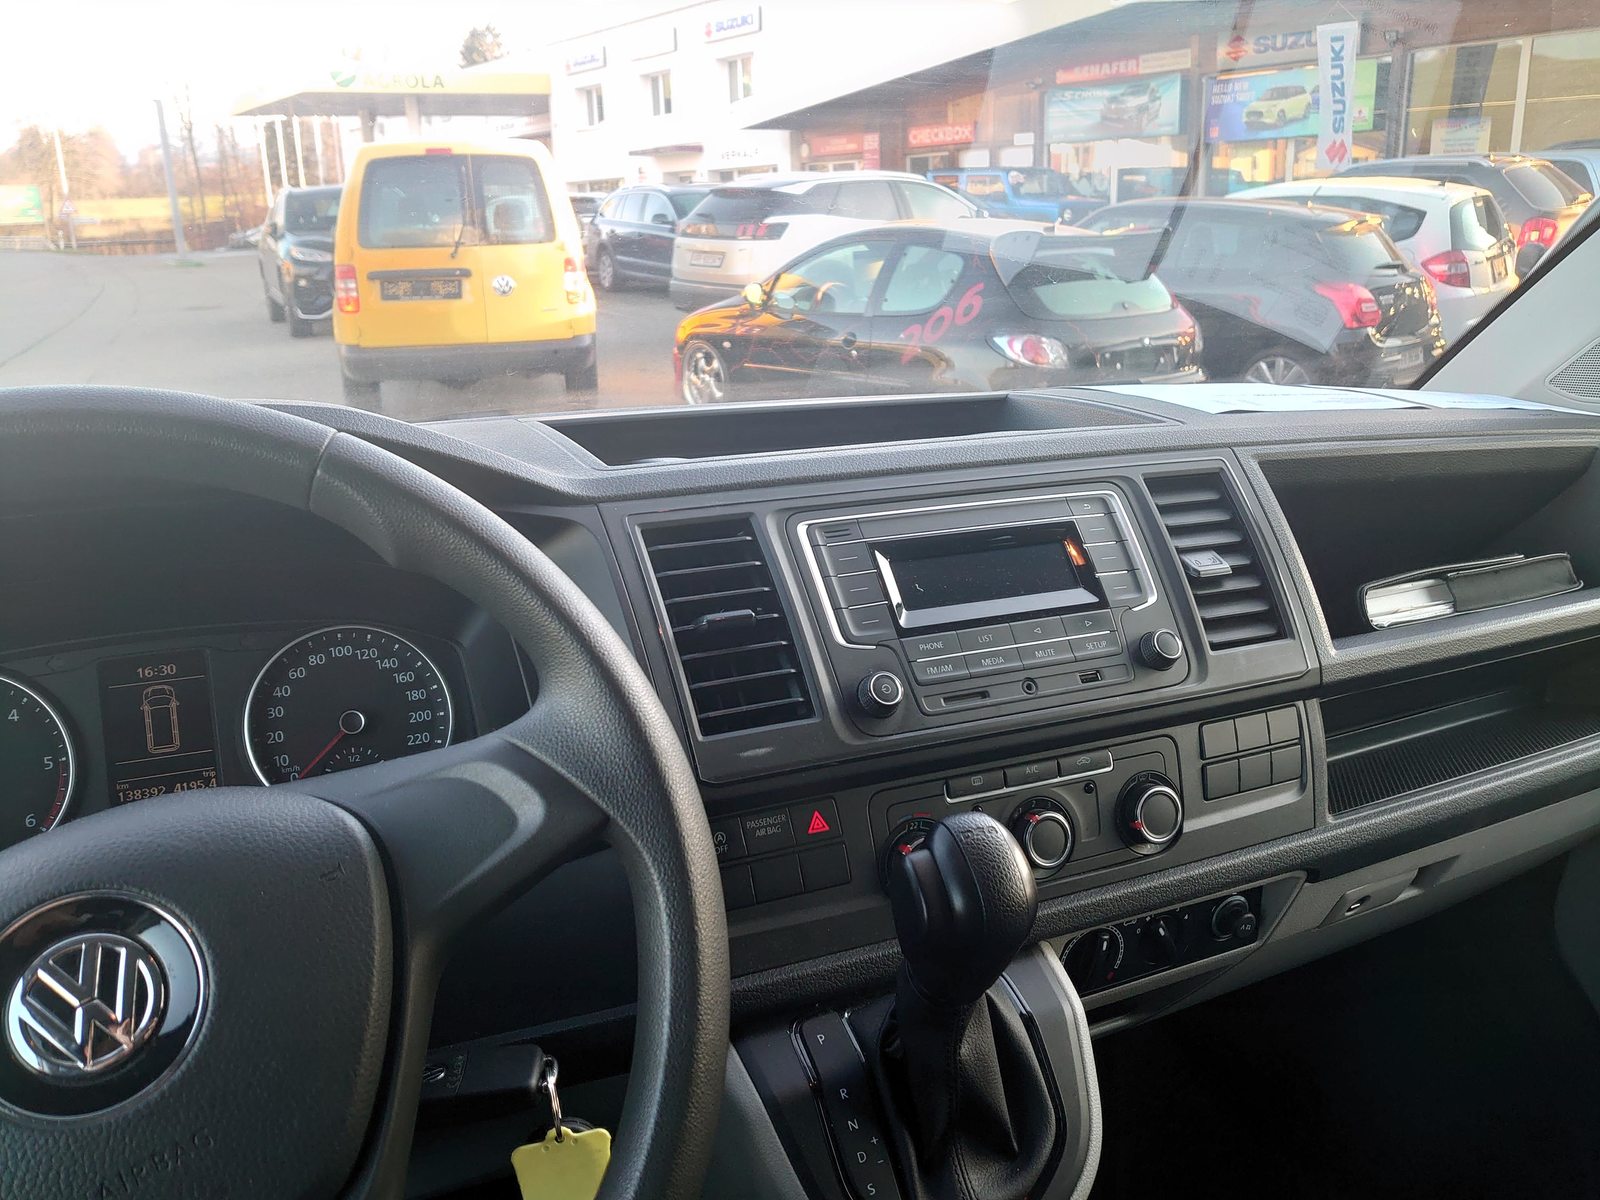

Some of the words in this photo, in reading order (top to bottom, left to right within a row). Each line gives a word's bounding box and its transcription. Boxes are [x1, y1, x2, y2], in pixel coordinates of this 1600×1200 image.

[716, 14, 753, 32] SUZUKI
[1252, 30, 1317, 54] SUZU
[1330, 35, 1346, 134] SUZUKI
[908, 126, 972, 144] CHECKBOX
[901, 281, 985, 366] 206
[919, 640, 945, 651] PHONE
[977, 634, 993, 644] LIST
[1086, 640, 1107, 650] SETUP
[329, 645, 353, 658] 100
[355, 648, 378, 660] 120
[1035, 648, 1056, 658] MUTE
[308, 653, 326, 666] 80
[376, 657, 398, 670] 140
[981, 657, 1005, 667] MEDIA
[136, 663, 177, 679] 16:30
[288, 666, 306, 680] 60
[926, 664, 953, 676] FM/AM
[392, 671, 415, 684] 160
[272, 685, 291, 698] 40
[405, 688, 427, 702] 180
[7, 708, 20, 722] 4
[267, 705, 284, 719] 30
[408, 709, 432, 723] 200
[266, 730, 284, 744] 20
[406, 732, 430, 746] 220
[43, 756, 54, 770] 5
[273, 754, 289, 768] 10
[348, 754, 361, 763] 1/2
[202, 769, 217, 779] trip
[281, 764, 301, 774] km/h
[1025, 764, 1039, 774] A/C
[116, 782, 129, 790] km
[173, 778, 218, 794] 4195.4
[118, 785, 167, 802] 138392
[25, 813, 36, 828] 6
[746, 813, 787, 830] PASSENGER
[816, 1033, 825, 1045] P
[839, 1088, 849, 1099] R
[847, 1118, 859, 1131] N
[857, 1151, 867, 1163] D
[867, 1183, 876, 1196] S
